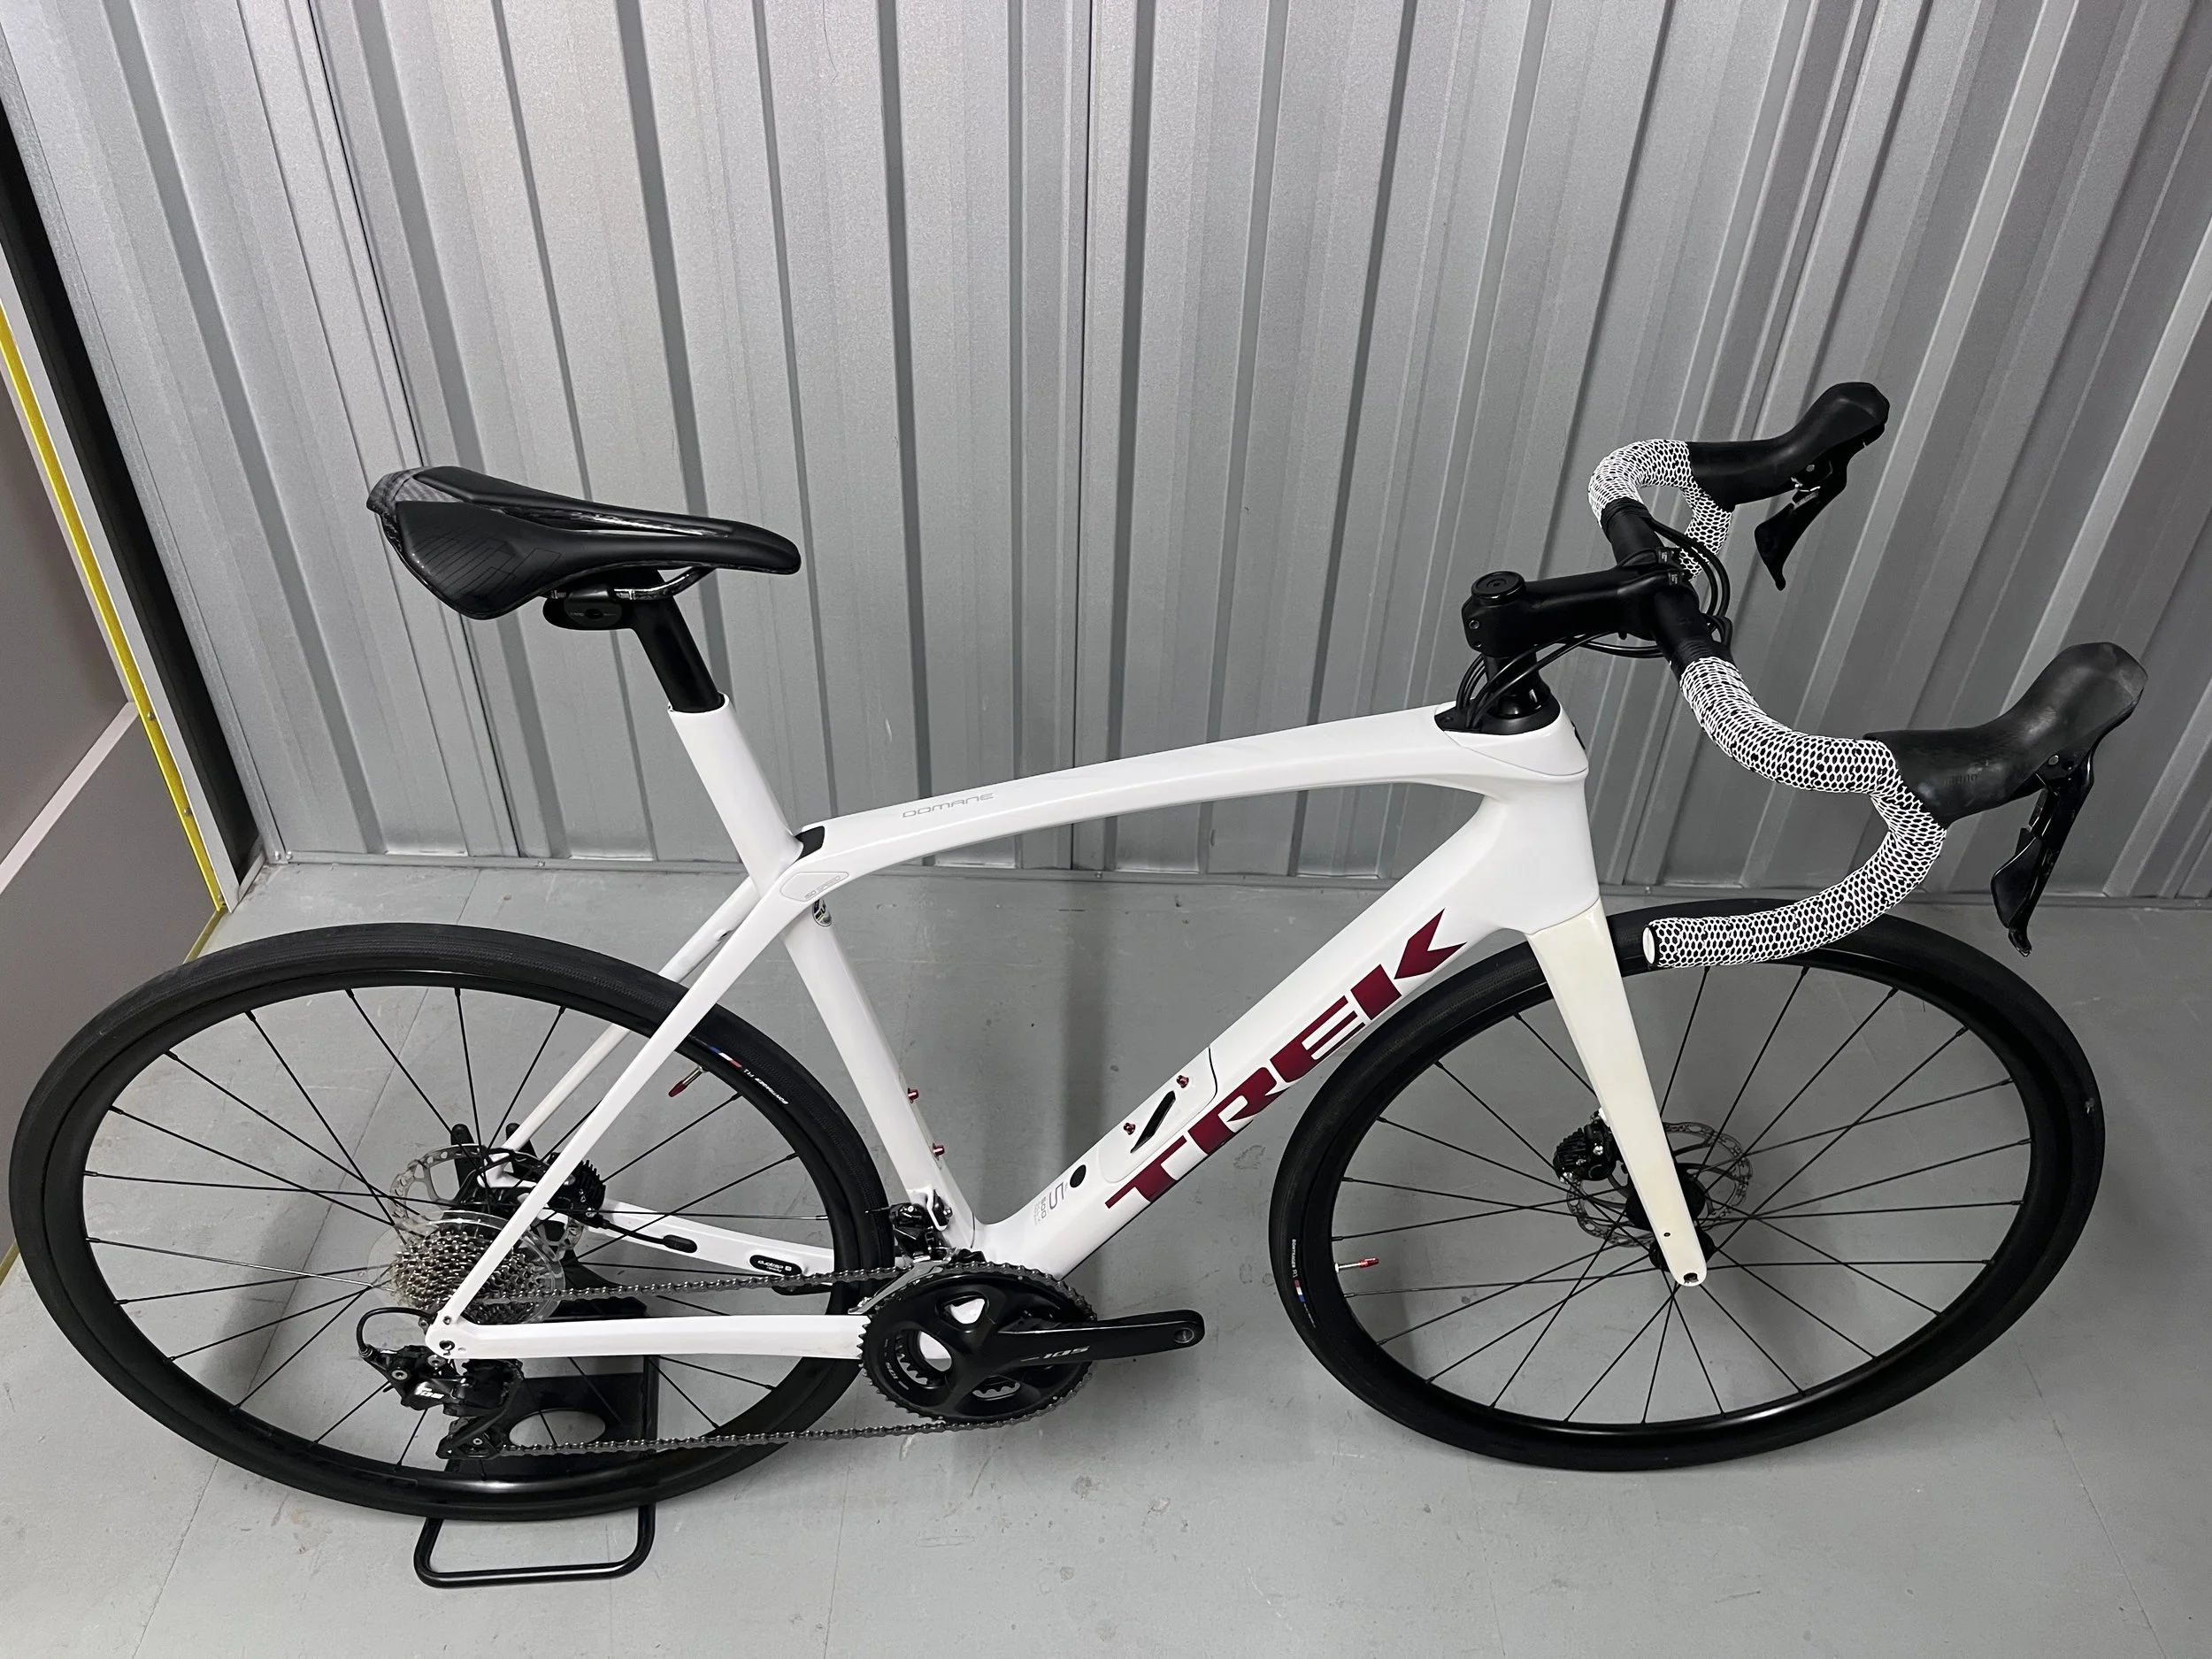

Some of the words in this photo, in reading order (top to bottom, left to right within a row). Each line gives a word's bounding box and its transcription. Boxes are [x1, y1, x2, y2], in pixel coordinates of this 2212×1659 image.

[902, 793, 995, 818] DOMANE
[1104, 908, 1467, 1210] TREK
[1043, 1345, 1091, 1359] 105
